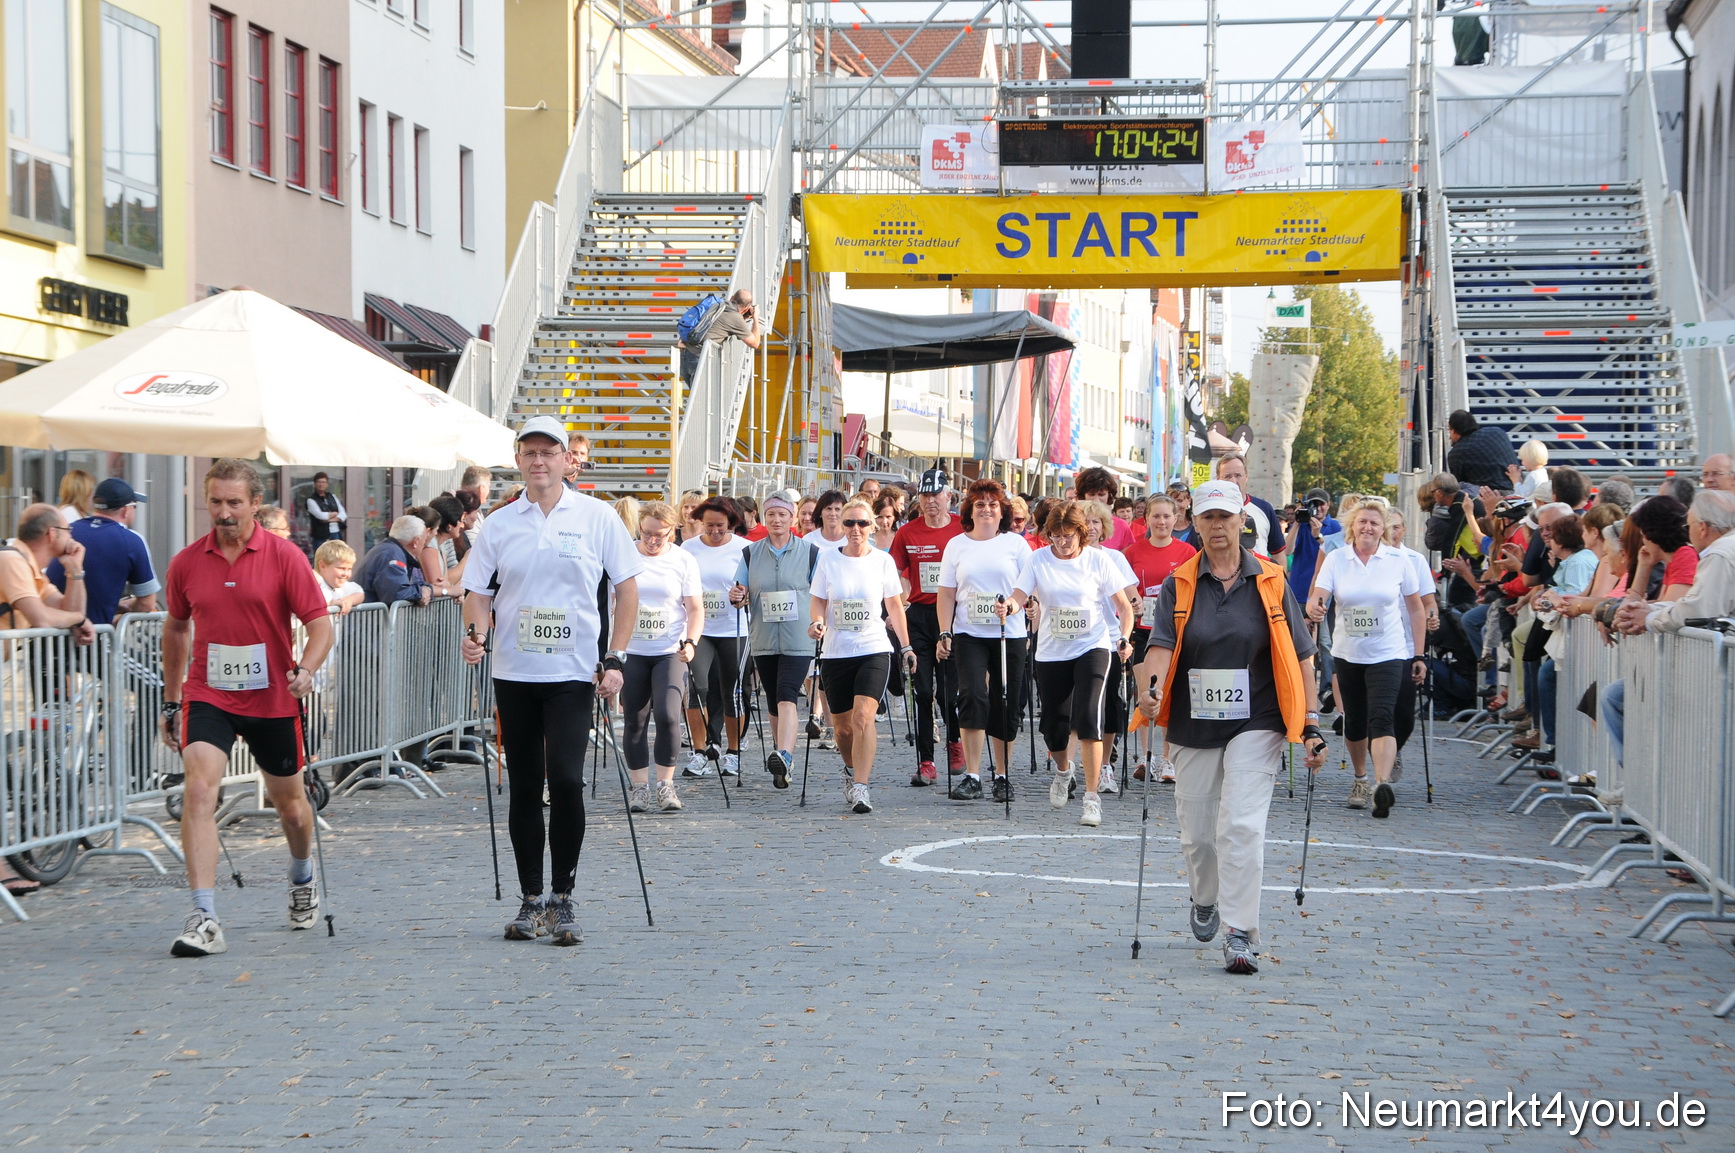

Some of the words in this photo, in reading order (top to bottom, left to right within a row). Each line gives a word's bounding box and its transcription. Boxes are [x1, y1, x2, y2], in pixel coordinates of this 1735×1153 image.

[1062, 123, 1108, 131] Elektronische
[1110, 121, 1195, 131] Sportstätteneinrichtungen
[1094, 129, 1199, 159] 17:04:24
[933, 159, 963, 170] DKMS
[1070, 176, 1143, 186] www.dkms.de
[995, 211, 1199, 259] START
[1235, 235, 1306, 247] Neumarkter
[1309, 233, 1366, 246] Stadtlauf
[835, 236, 904, 248] Neumarkter
[906, 237, 961, 248] Stadtlauf
[1278, 305, 1304, 316] DAV
[123, 374, 219, 396] Segafredo
[558, 531, 582, 539] Walking
[703, 601, 726, 610] 8003
[771, 602, 794, 612] 8127
[977, 604, 995, 614] 800
[533, 610, 566, 621] Joachim
[844, 611, 870, 621] 8002
[639, 620, 666, 630] 8006
[1060, 619, 1087, 629] 8008
[1354, 617, 1379, 627] 8031
[533, 625, 571, 639] 8039
[223, 662, 262, 676] 8113
[1205, 688, 1244, 703] 8122
